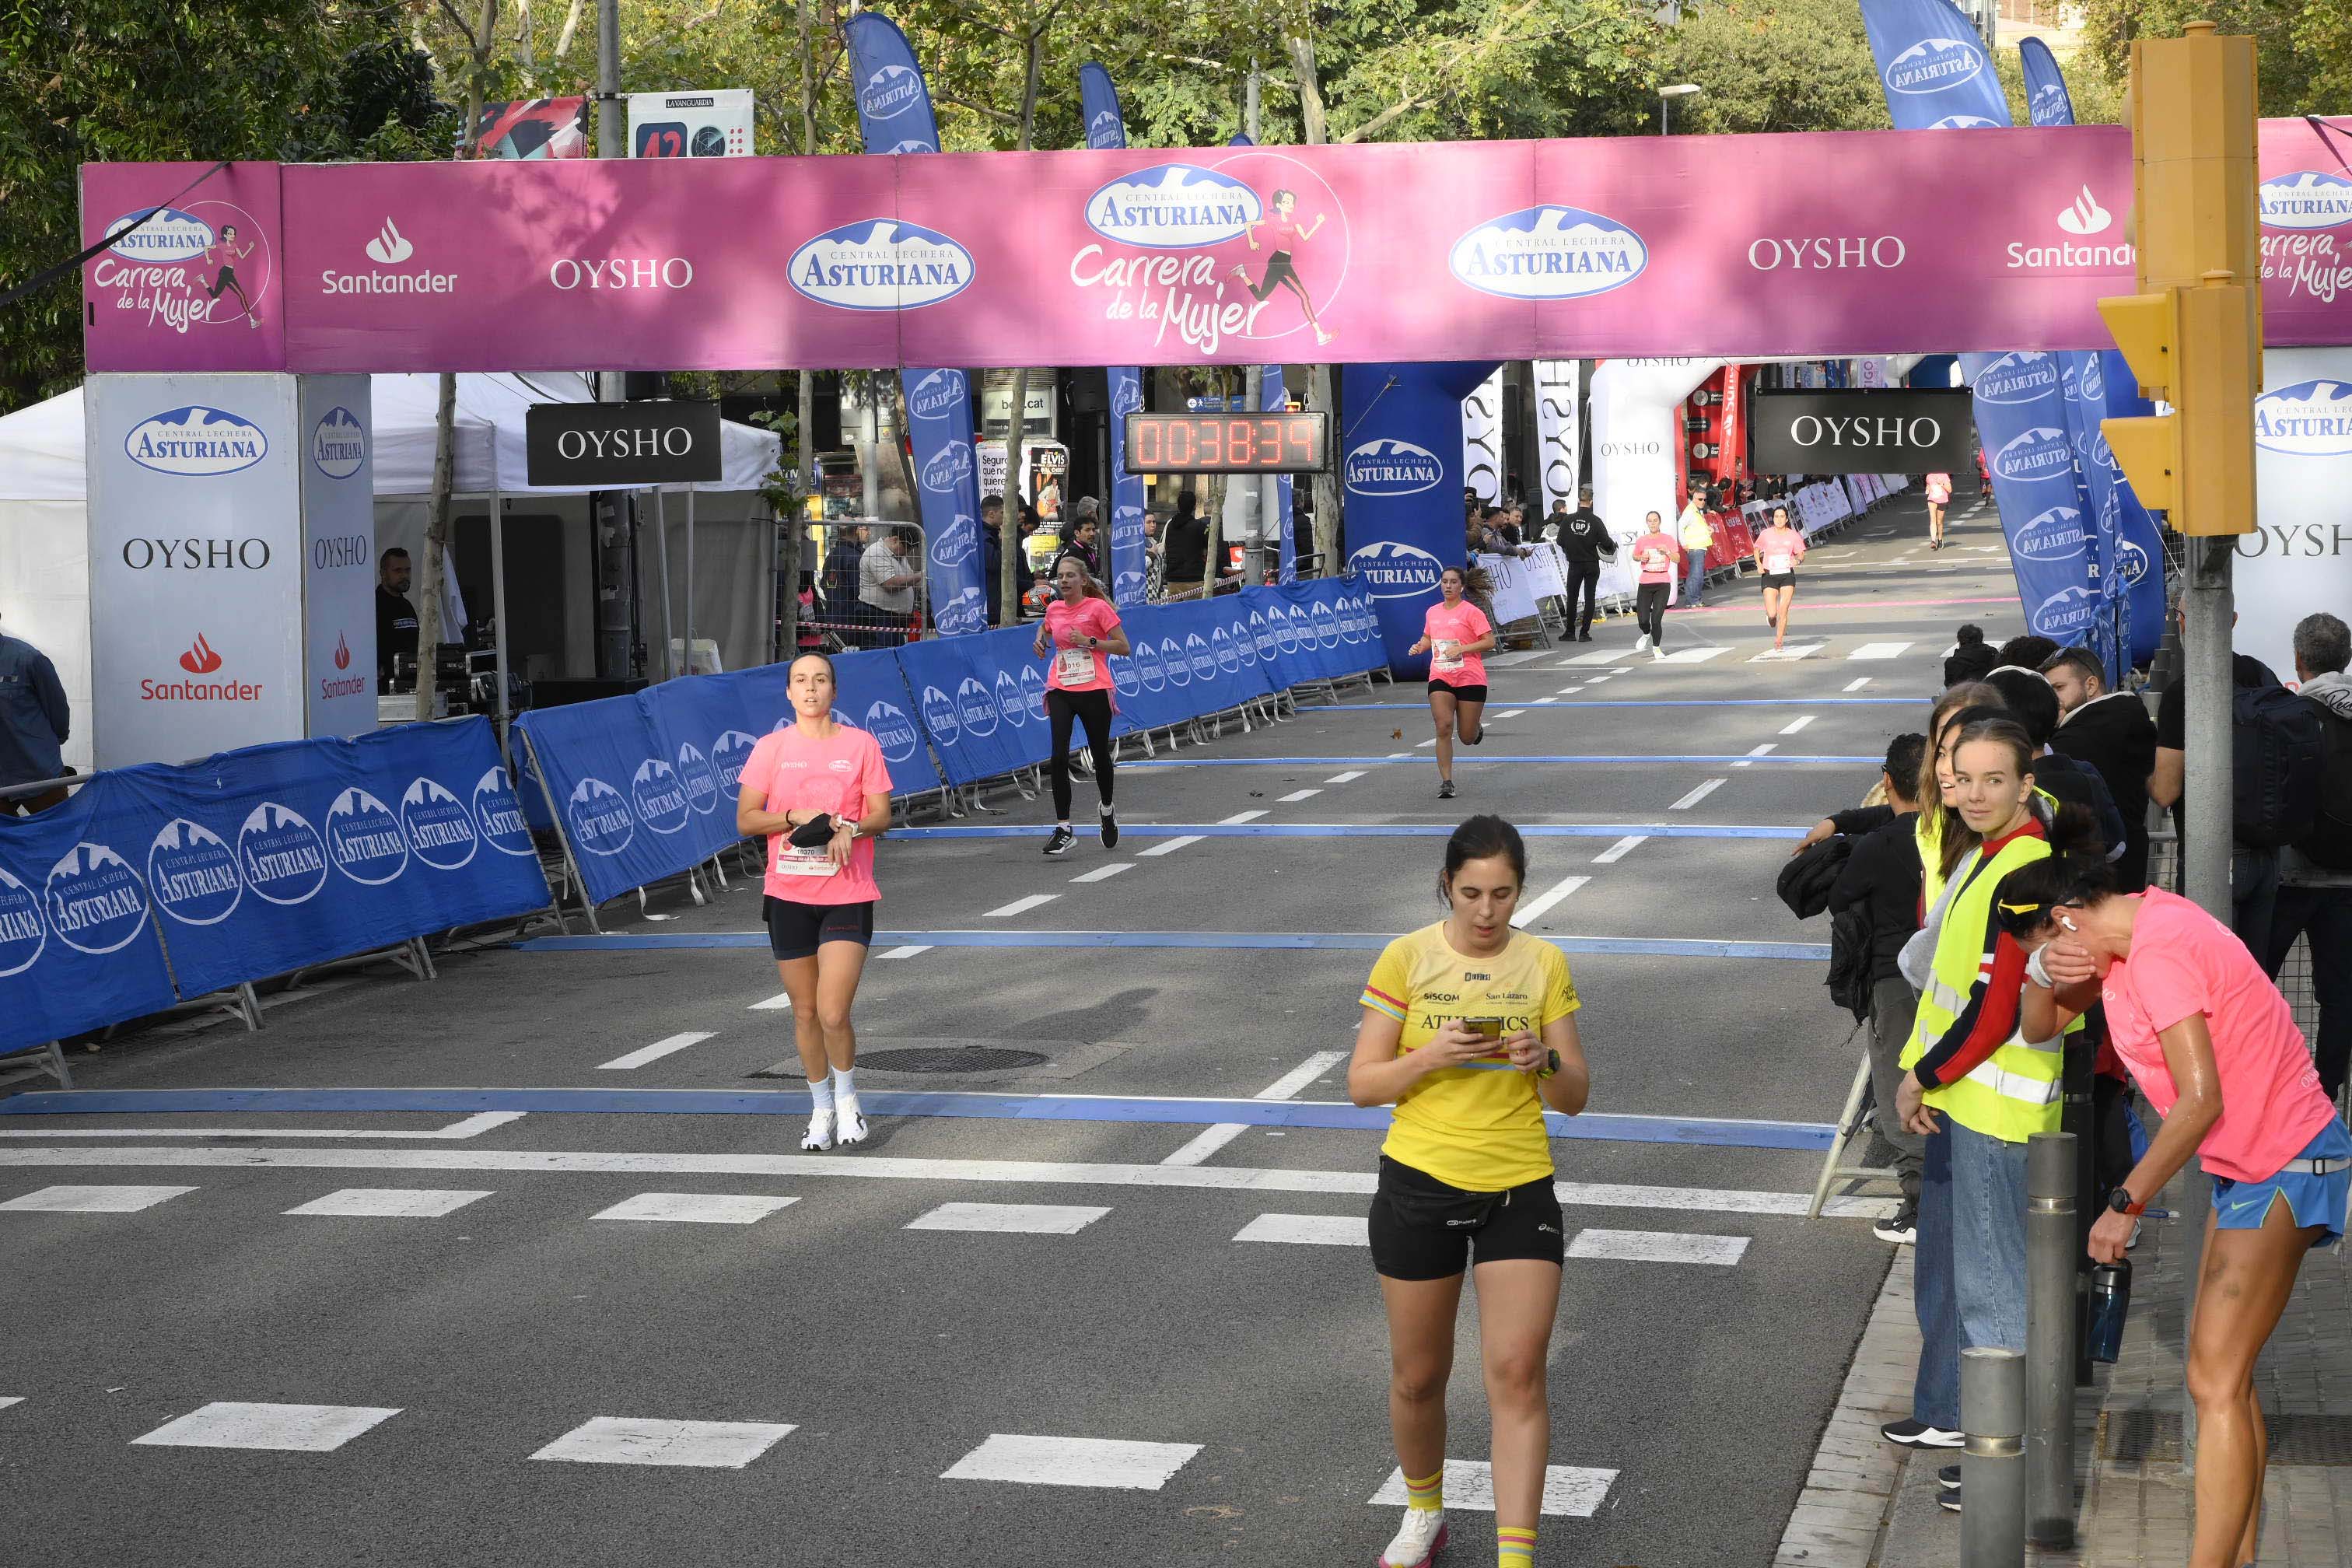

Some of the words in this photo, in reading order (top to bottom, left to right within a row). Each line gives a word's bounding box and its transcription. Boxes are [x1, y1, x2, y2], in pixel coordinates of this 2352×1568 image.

[1099, 196, 1246, 226] ASTURIANA
[112, 227, 205, 248] ASTURIANA
[1563, 236, 1626, 246] LECHERA
[2260, 234, 2333, 256] arrera
[831, 250, 888, 259] CENTRAL
[896, 250, 954, 258] LECHERA
[1070, 244, 1216, 287] Carrera
[1468, 242, 1632, 275] ASTURIANA
[1748, 236, 1905, 270] OYSHO
[2007, 242, 2135, 268] Santand
[94, 258, 186, 287] Carrera
[323, 269, 458, 294] Santander
[550, 257, 692, 289] OYSHO
[802, 254, 960, 286] ASTURIANA
[2289, 252, 2352, 303] Muje
[117, 289, 134, 309] de
[138, 289, 149, 309] la
[148, 282, 221, 334] Mujer
[1106, 289, 1132, 319] de
[1139, 289, 1157, 319] la
[1155, 282, 1269, 355] Mujer
[1002, 398, 1043, 409] b.cat
[1791, 415, 1940, 446] OYSHO
[2256, 409, 2352, 437] ASTURI
[136, 432, 257, 458] ASTURIANA
[317, 434, 362, 460] ASTURIANA
[558, 427, 692, 459] OYSHO
[1601, 441, 1659, 456] OYSHO
[1041, 454, 1064, 464] ELVIS
[1348, 462, 1435, 483] ASTURIANA
[983, 478, 1008, 486] quiere
[123, 538, 270, 569] OYSHO
[315, 535, 366, 569] OYSHO
[2235, 524, 2352, 557] OYSH
[1351, 564, 1437, 583] TURIANA
[141, 679, 263, 700] Santander
[322, 676, 365, 698] Santander
[341, 819, 366, 833] CENTRAL
[408, 815, 474, 850] ASTURIANA
[479, 802, 528, 838] ASTUR
[254, 837, 282, 851] CENTRAL
[334, 826, 404, 864] ASTURIANA
[166, 856, 197, 870] CENTRAL
[246, 845, 324, 884] ASTURIANA
[157, 863, 238, 905] ASTURIANA
[0, 909, 42, 943] RIANA
[1421, 1013, 1529, 1031] ATICS
